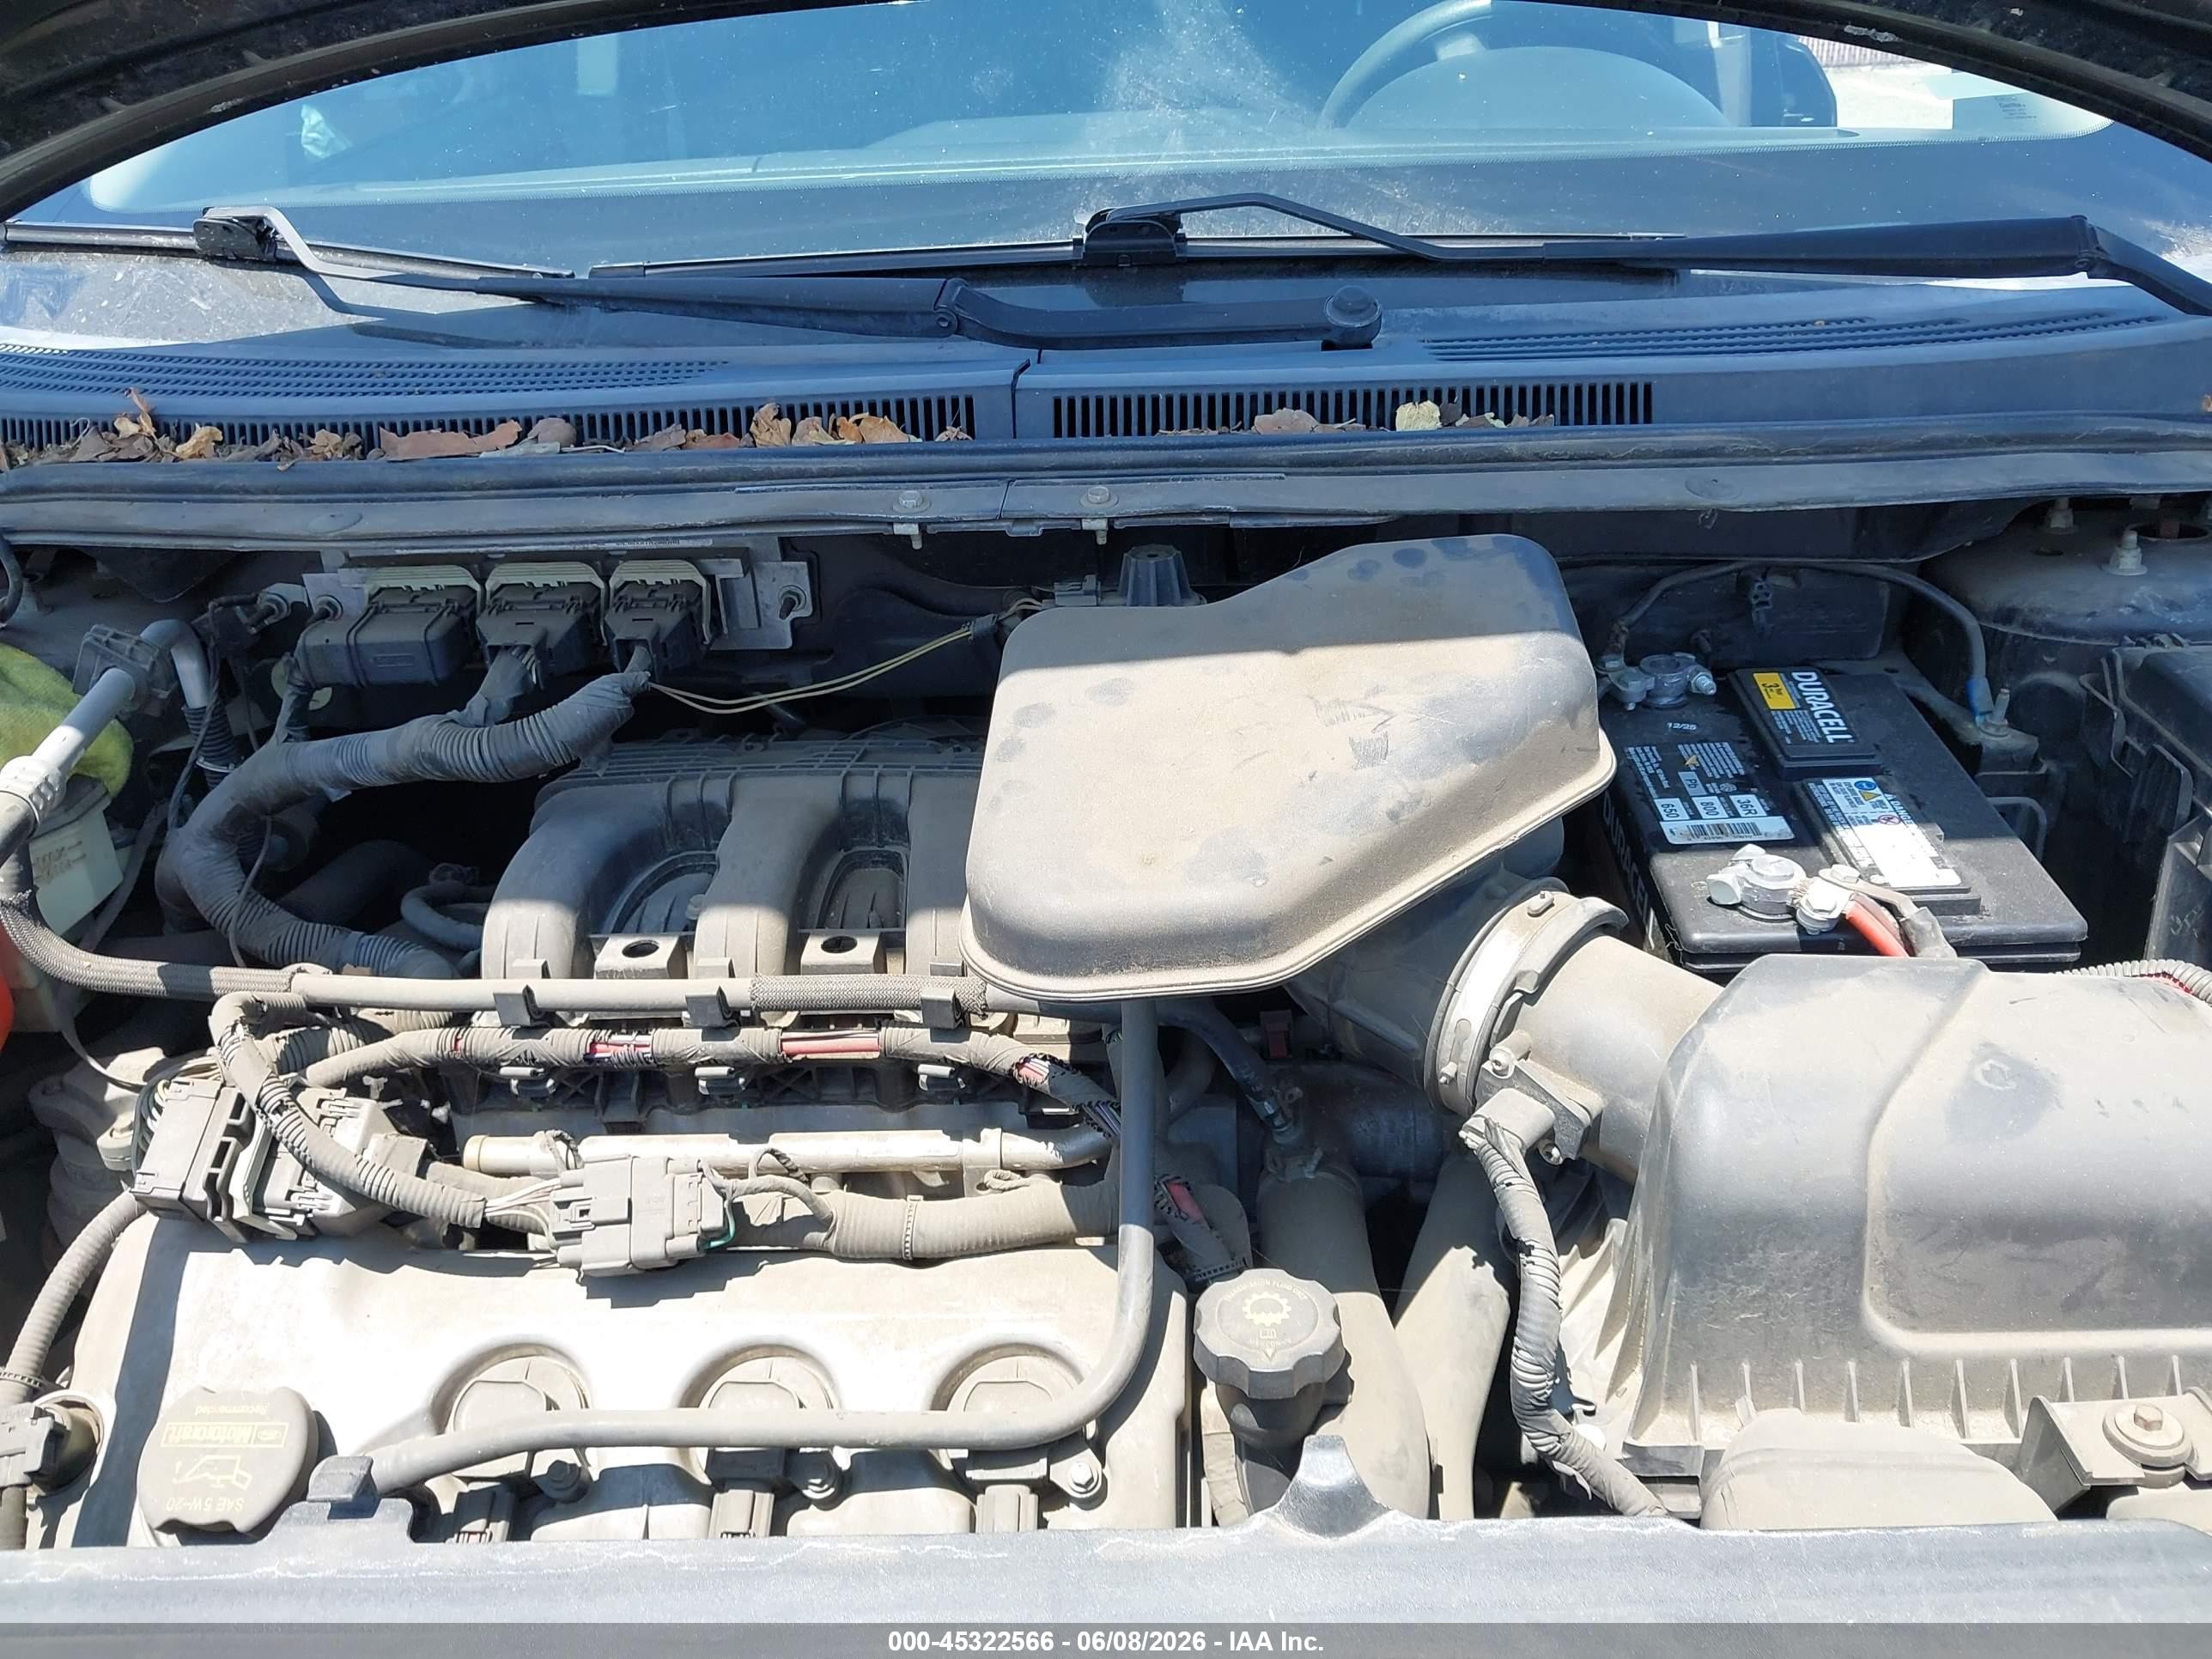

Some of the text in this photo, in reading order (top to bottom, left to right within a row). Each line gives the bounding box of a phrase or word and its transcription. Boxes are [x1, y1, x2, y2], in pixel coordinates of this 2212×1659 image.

[1791, 672, 1852, 744] DURACELL
[1685, 779, 1697, 789] Pb
[1661, 803, 1680, 818] 650
[1699, 800, 1720, 817] 800
[1736, 799, 1758, 816] 36R
[167, 1425, 252, 1444] Motorcraft
[217, 1498, 245, 1512] SAE
